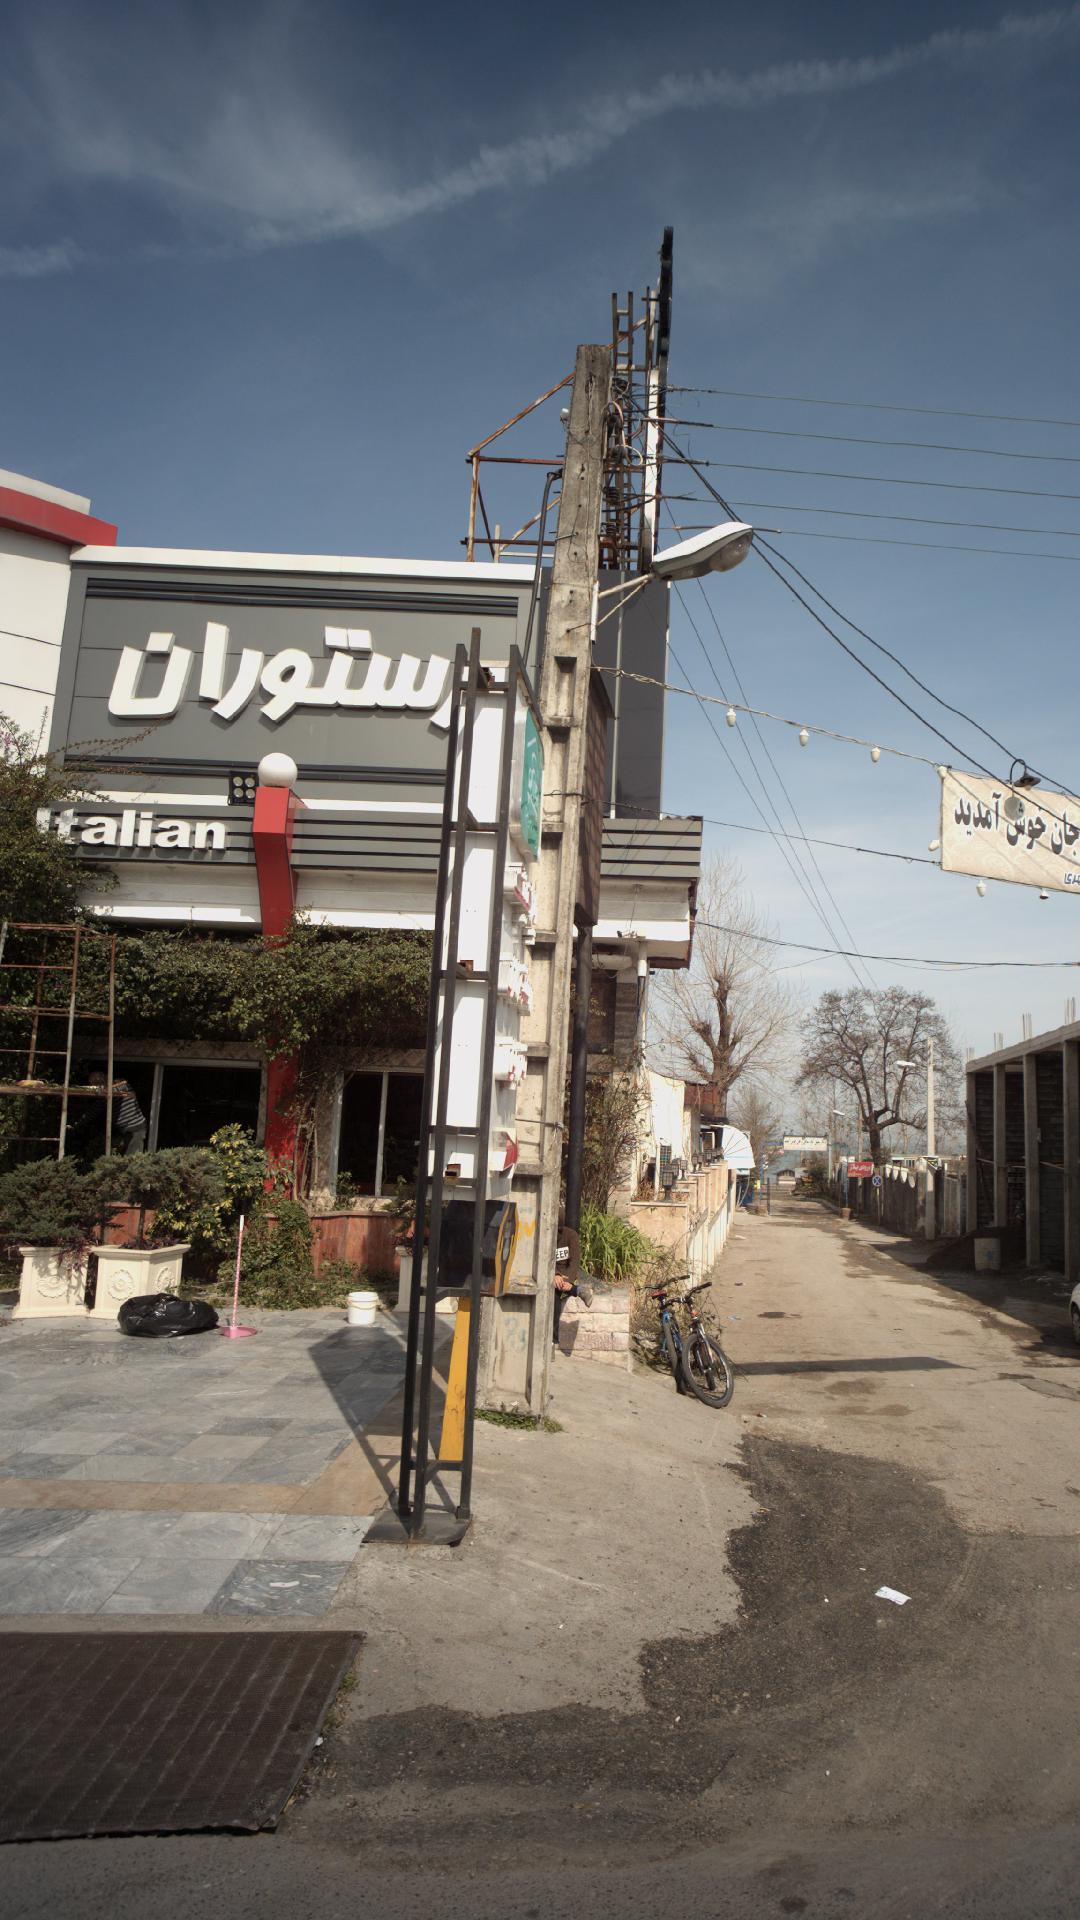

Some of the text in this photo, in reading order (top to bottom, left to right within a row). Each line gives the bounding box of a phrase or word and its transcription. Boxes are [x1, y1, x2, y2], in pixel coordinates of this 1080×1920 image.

[35, 808, 226, 850] Italian
[954, 792, 1002, 836] آمدید
[1007, 801, 1046, 850] خوش
